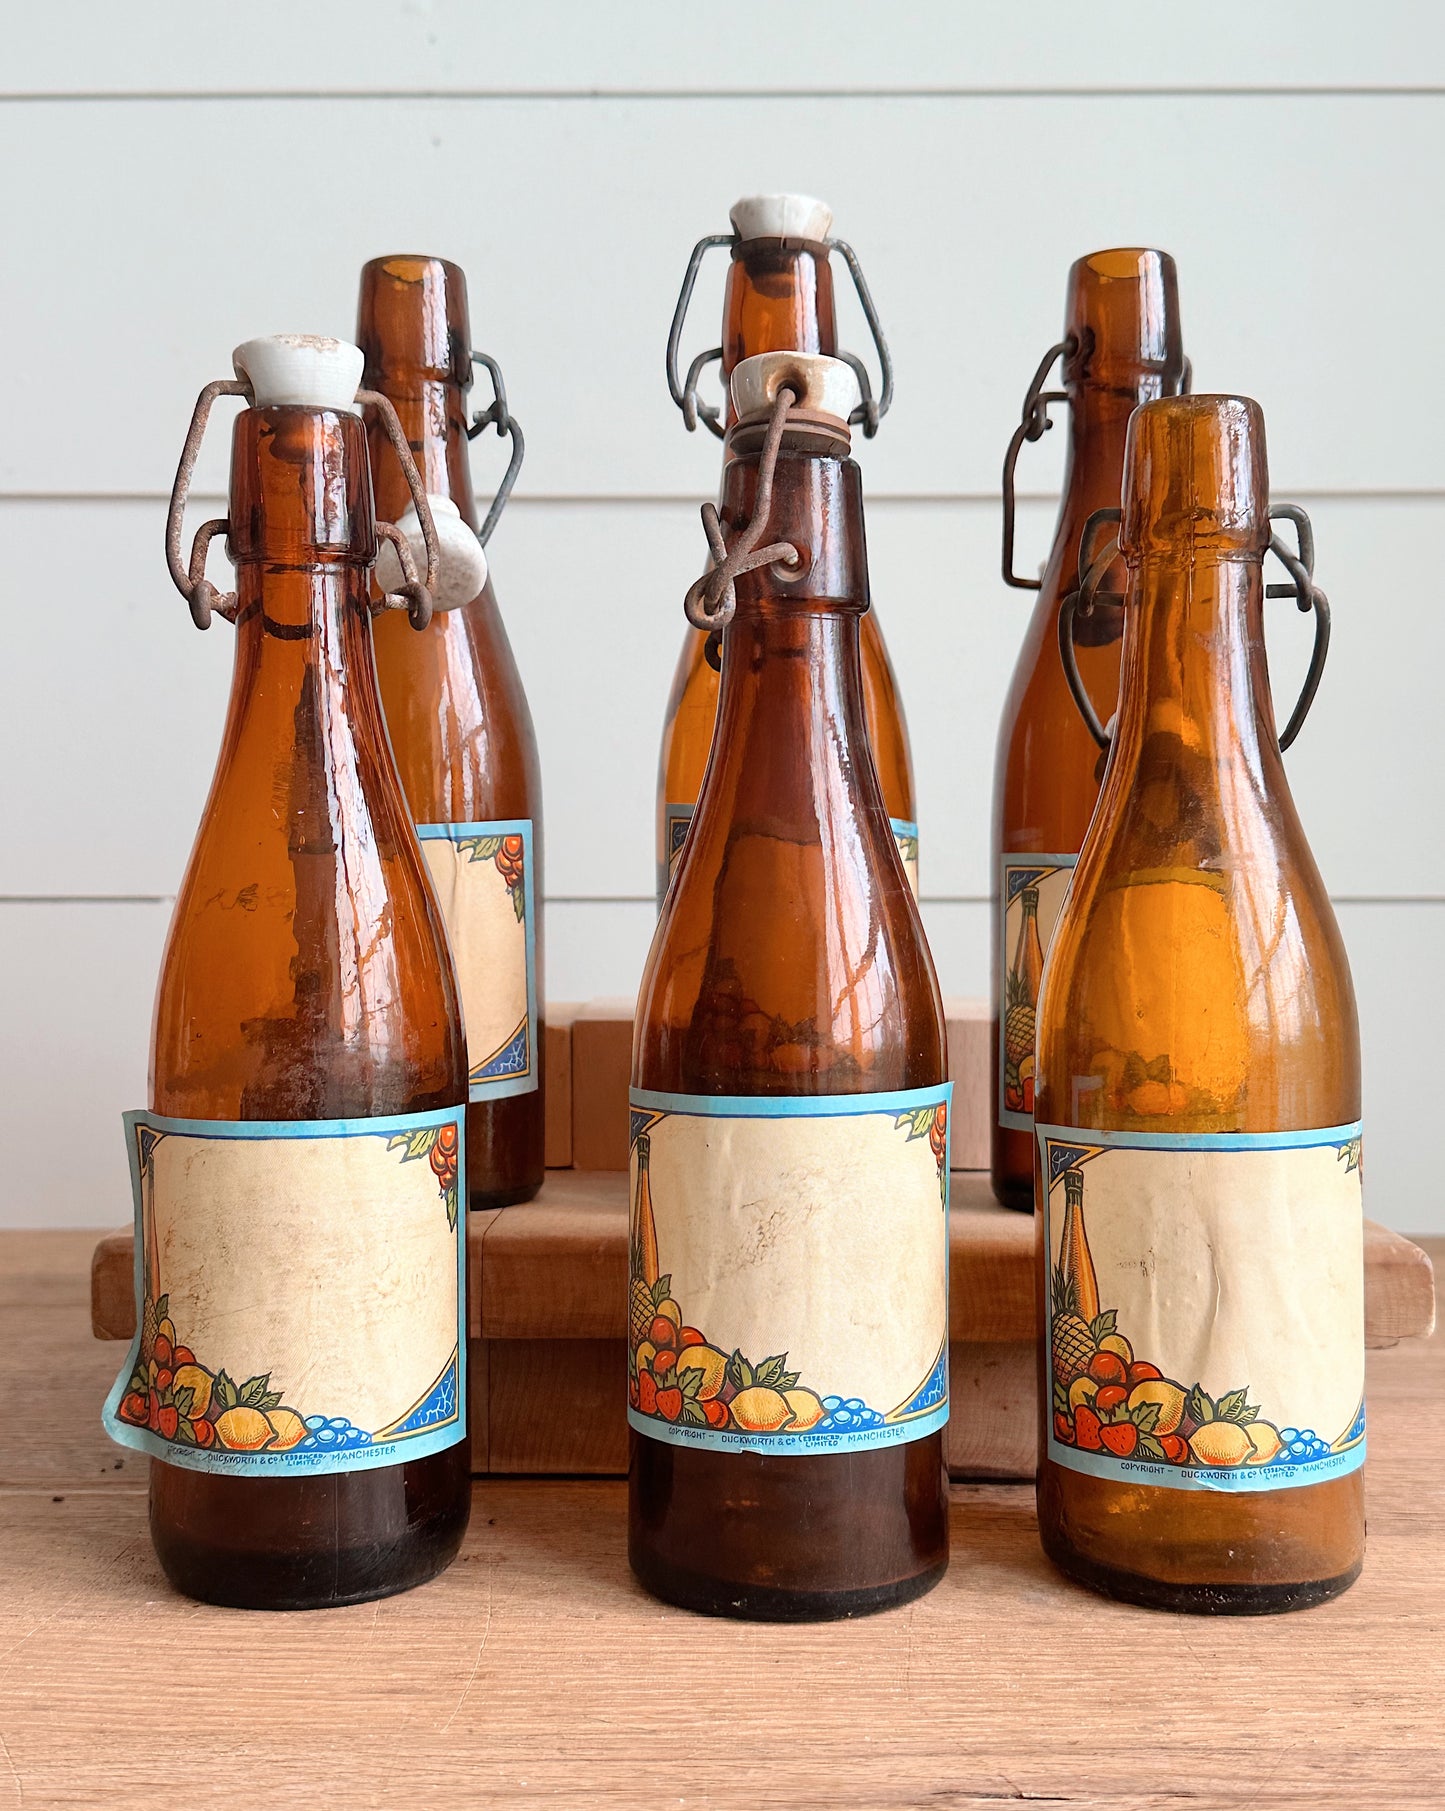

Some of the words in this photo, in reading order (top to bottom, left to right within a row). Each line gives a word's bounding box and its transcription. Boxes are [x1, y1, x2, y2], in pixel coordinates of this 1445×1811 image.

[668, 1426, 706, 1440] COPYRIGHT
[721, 1435, 775, 1446] DUCKWORTH
[847, 1426, 905, 1443] MANCHESTER
[331, 1445, 396, 1461] MANCHESTER
[1120, 1462, 1165, 1474] COPYRIGHT
[1181, 1470, 1238, 1480] DUCKWORTH
[1302, 1455, 1347, 1473] MANCHESTER
